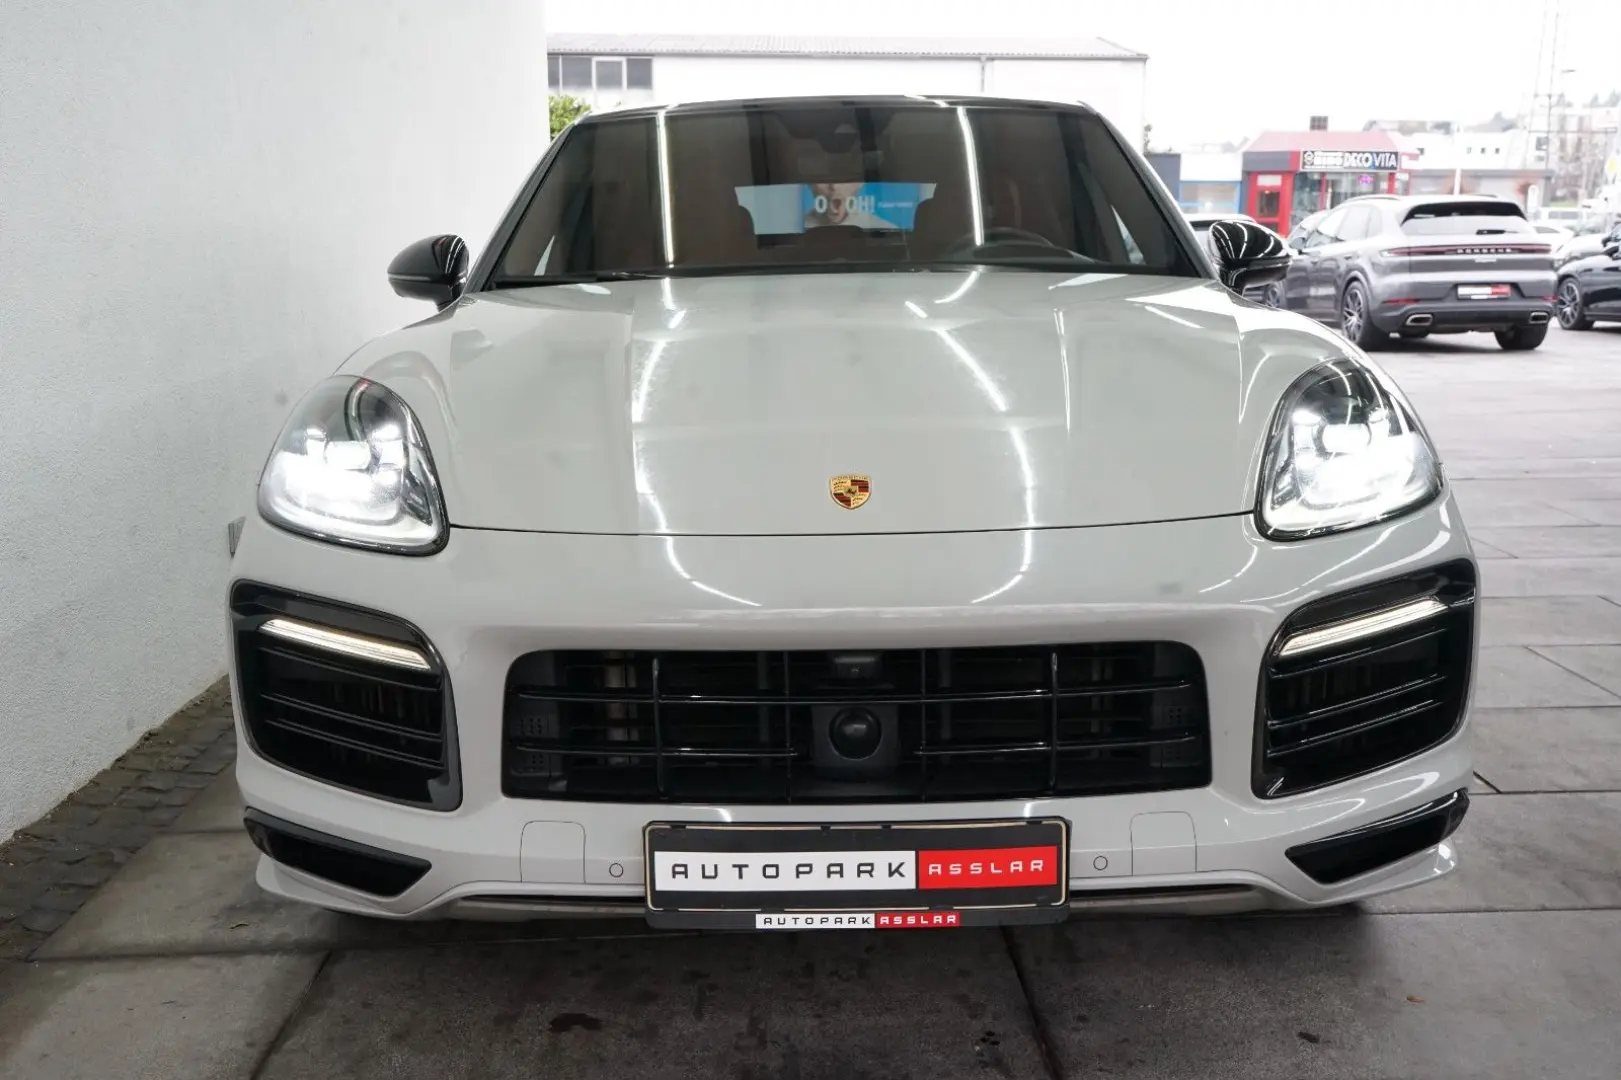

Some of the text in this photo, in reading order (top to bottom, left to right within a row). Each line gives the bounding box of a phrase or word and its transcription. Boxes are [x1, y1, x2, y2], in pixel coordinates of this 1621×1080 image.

[1344, 152, 1372, 167] DECO
[1374, 153, 1397, 168] VITA
[671, 859, 1045, 880] AUTOPARK ASSLAR
[763, 914, 957, 926] AUTOPARK ASSLAR
